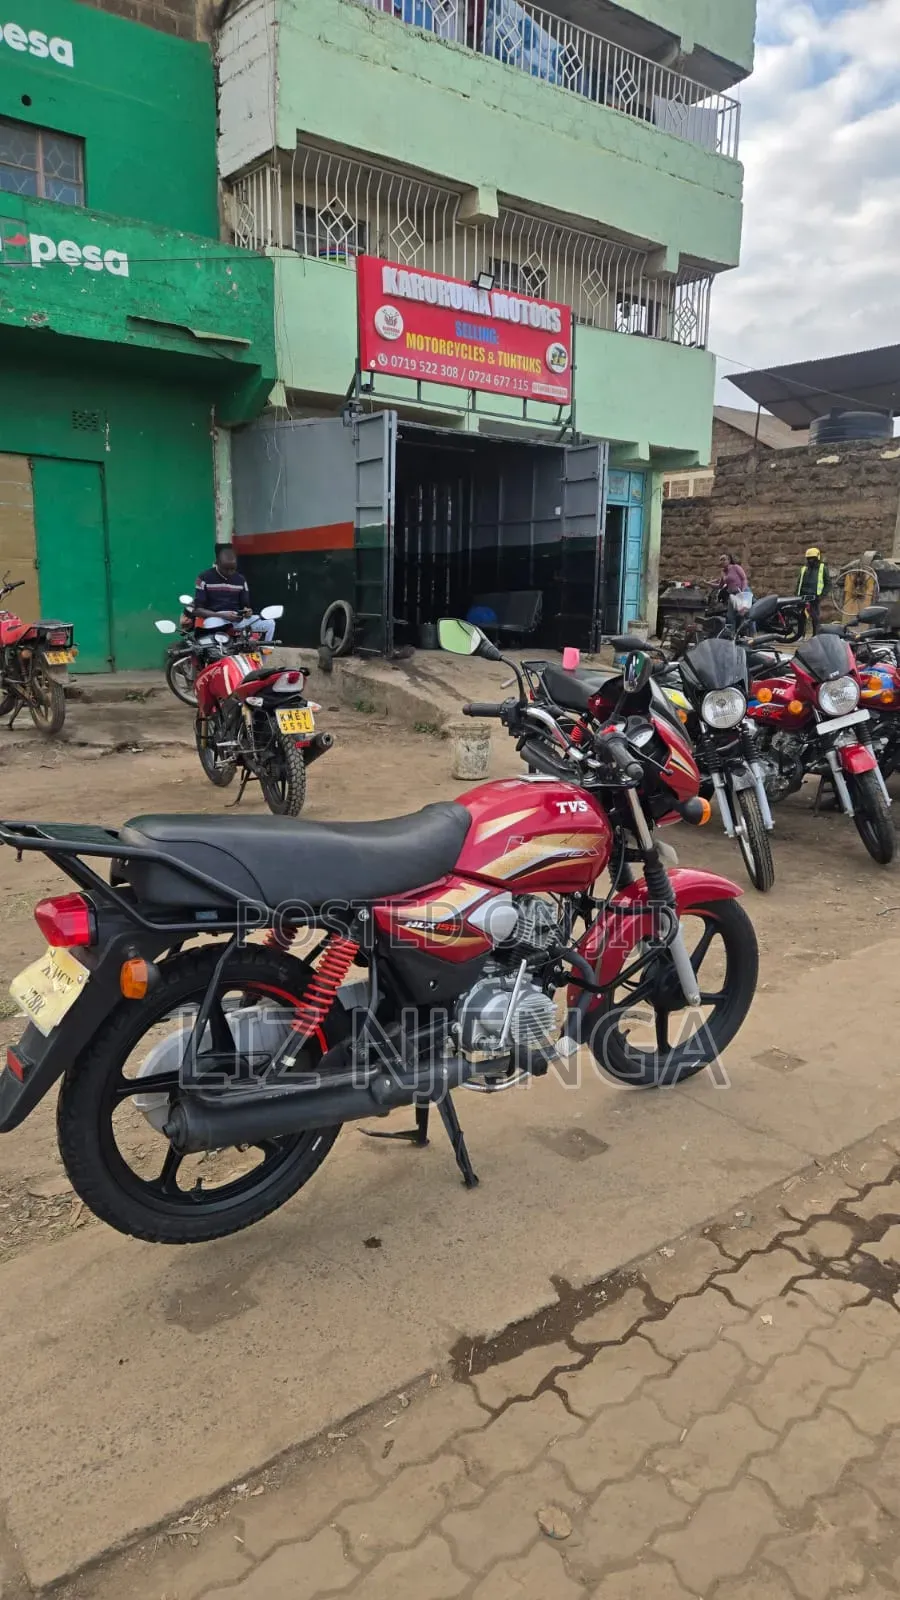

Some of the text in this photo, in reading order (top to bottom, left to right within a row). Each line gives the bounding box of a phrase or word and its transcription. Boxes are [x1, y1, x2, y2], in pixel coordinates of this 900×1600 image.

[0, 22, 74, 68] esa
[492, 292, 562, 333] MOTORS
[391, 355, 416, 371] 0719
[420, 360, 438, 375] 522
[441, 364, 458, 379] 308
[468, 369, 491, 384] 0724
[493, 374, 510, 388] 677
[513, 378, 529, 391] 115
[406, 333, 541, 374] MOTORCYCLES & TUKTUKS
[555, 800, 588, 815] TVS
